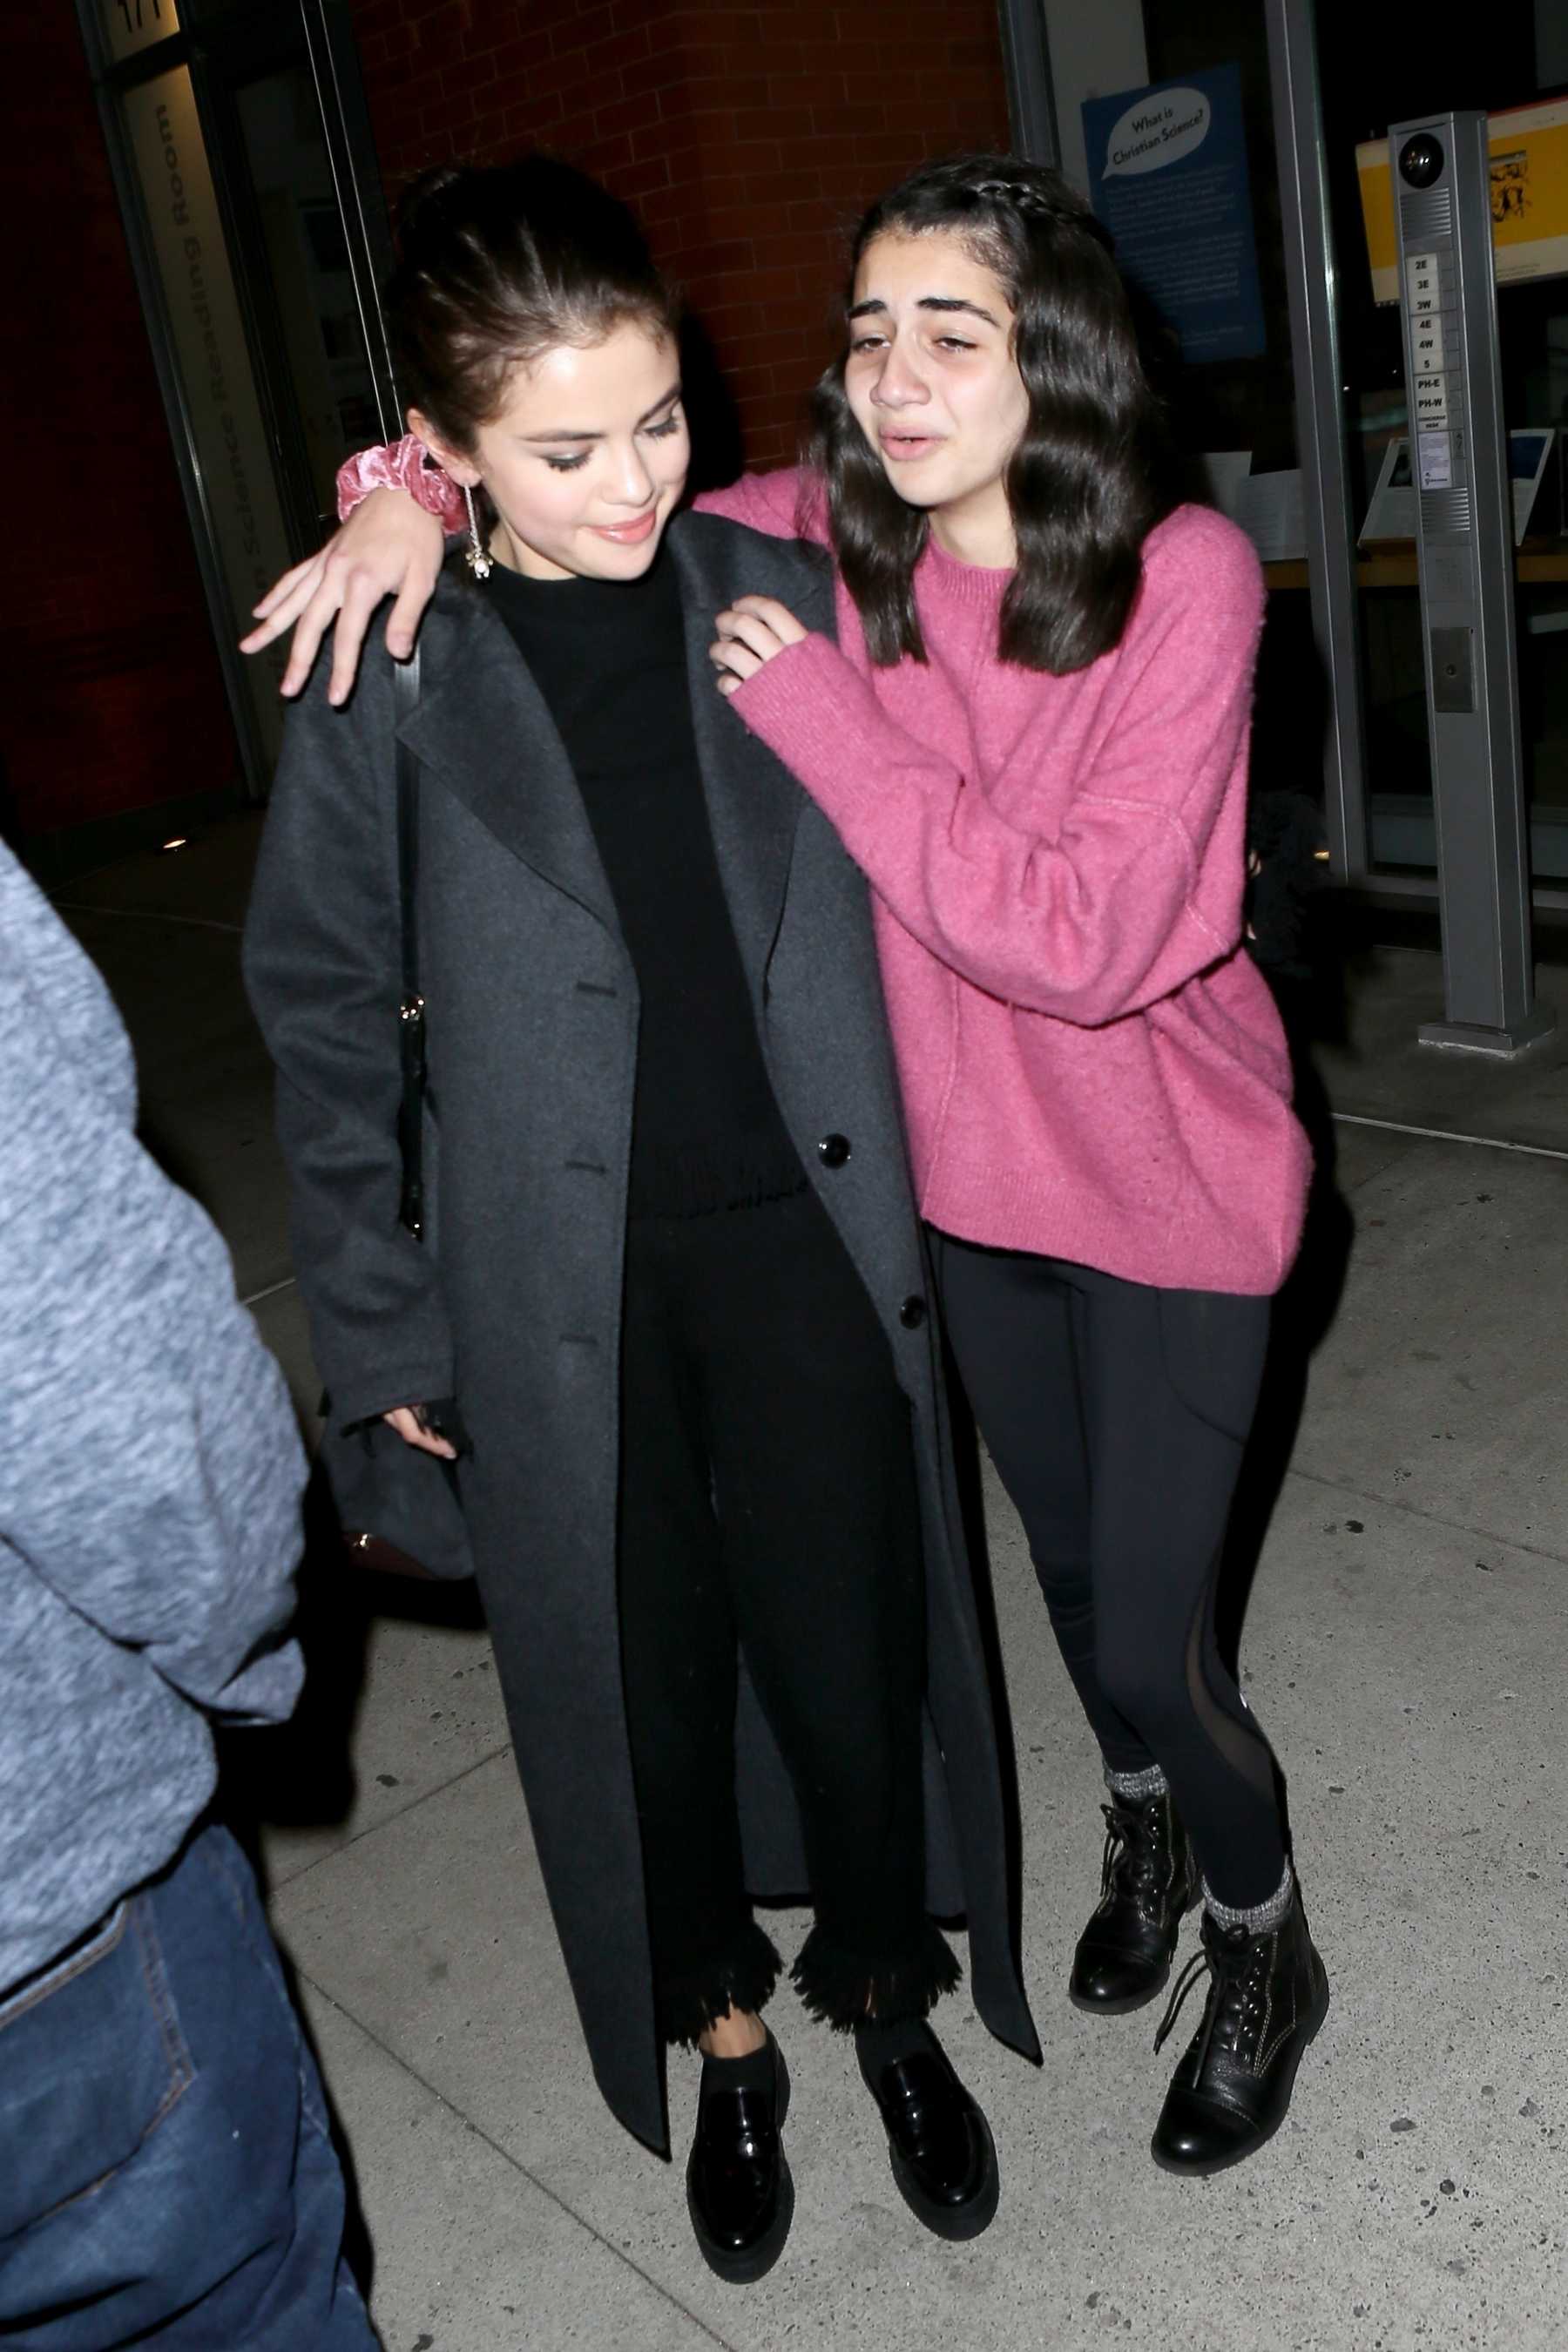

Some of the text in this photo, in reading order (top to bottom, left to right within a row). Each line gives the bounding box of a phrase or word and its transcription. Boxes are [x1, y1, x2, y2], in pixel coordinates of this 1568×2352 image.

[1131, 106, 1173, 133] What is
[1112, 108, 1204, 166] Christian Science?
[1416, 260, 1428, 270] 2E
[1417, 280, 1429, 289] 3E
[1417, 300, 1431, 310] 3W
[1419, 320, 1431, 329] 4E
[156, 104, 261, 556] Science Reading Room
[1419, 340, 1434, 349] 4W
[1423, 360, 1430, 368] 5
[1418, 378, 1441, 389] PH-E
[1418, 397, 1443, 409] PH-W
